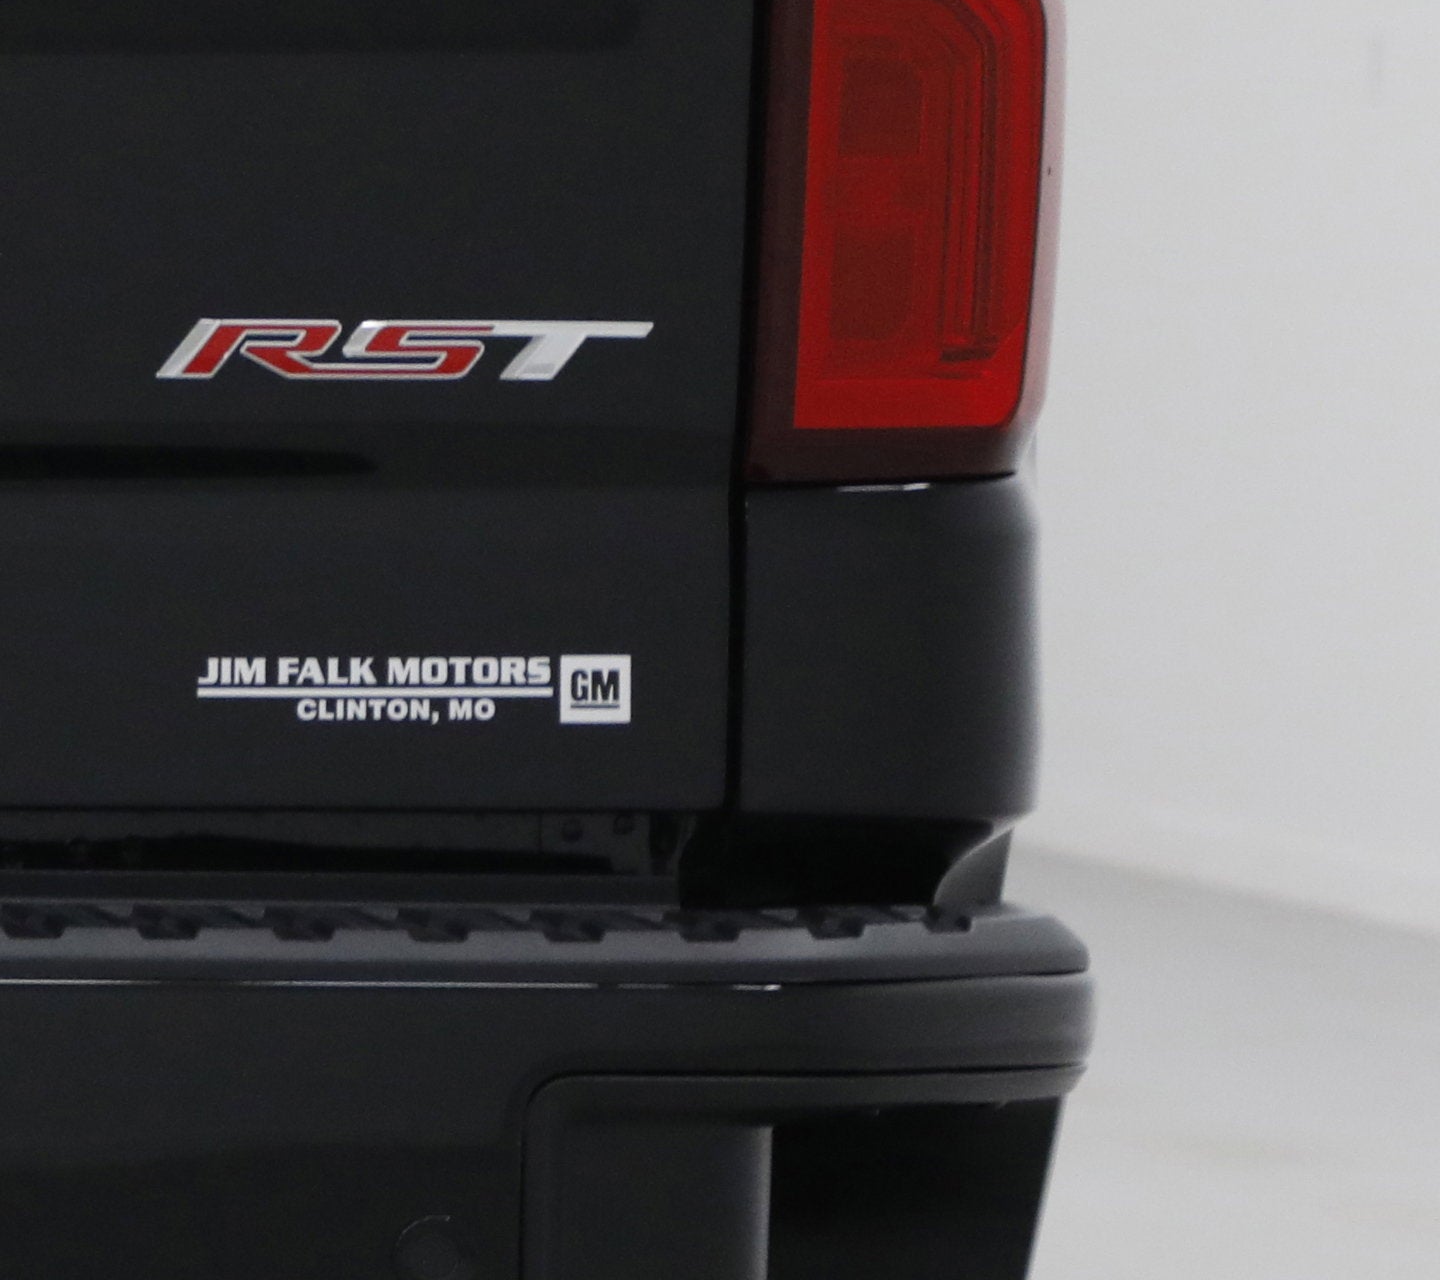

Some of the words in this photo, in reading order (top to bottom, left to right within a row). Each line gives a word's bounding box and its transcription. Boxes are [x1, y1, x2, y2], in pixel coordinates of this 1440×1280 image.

[155, 317, 654, 381] RST
[197, 656, 267, 685] JIM
[277, 656, 377, 685] FALK
[386, 656, 551, 685] MOTORS
[296, 697, 440, 725] CLINTON,
[447, 697, 497, 722] MO
